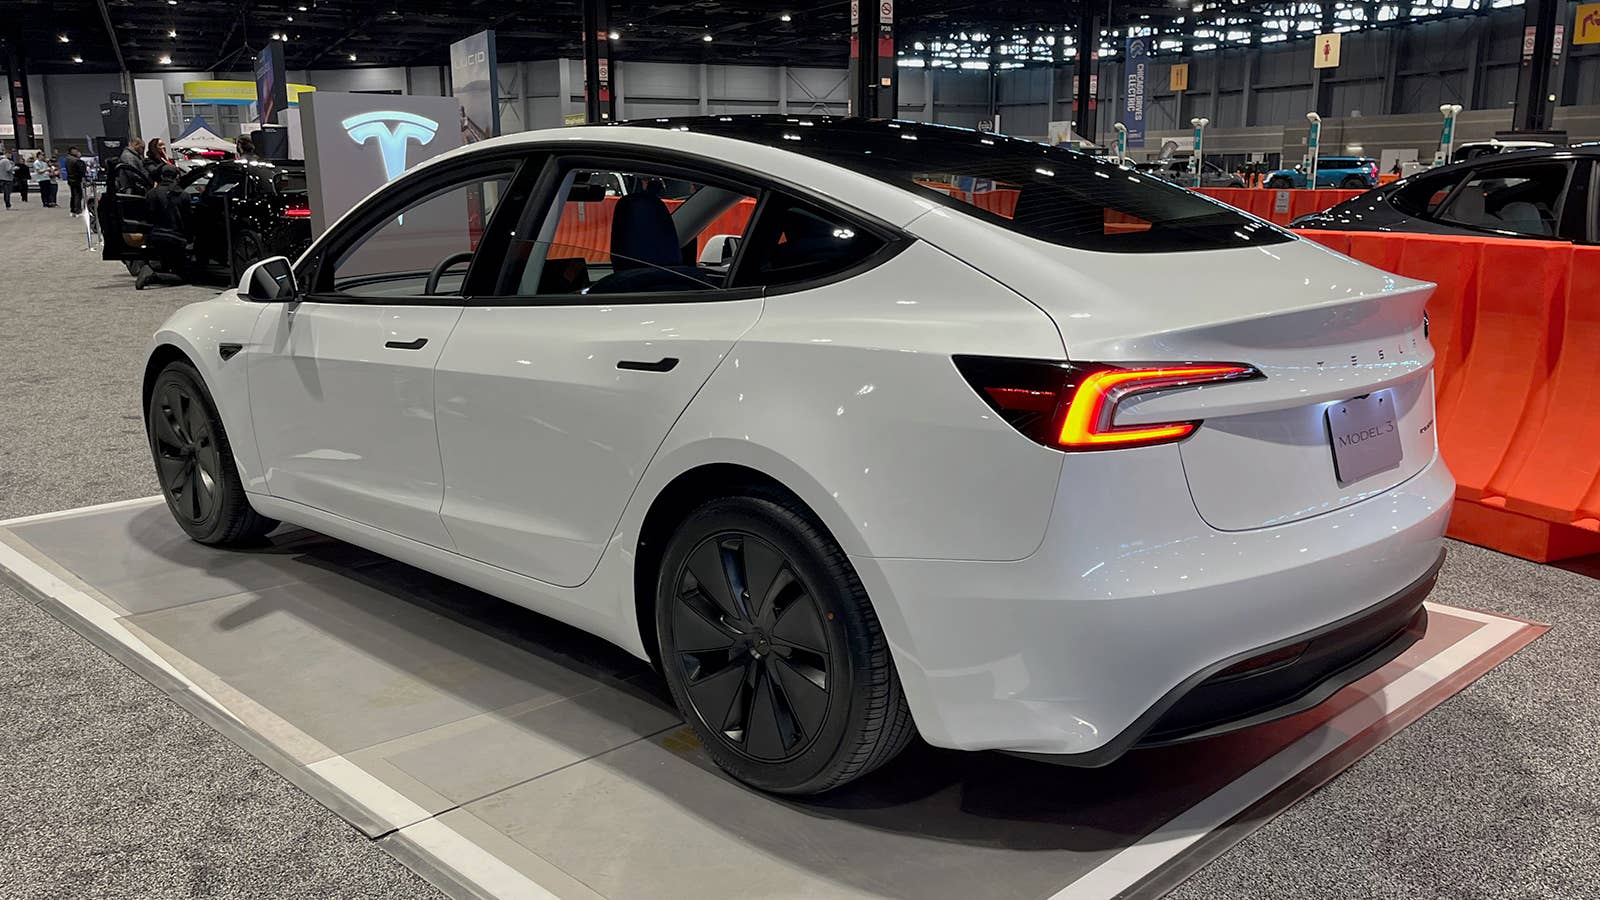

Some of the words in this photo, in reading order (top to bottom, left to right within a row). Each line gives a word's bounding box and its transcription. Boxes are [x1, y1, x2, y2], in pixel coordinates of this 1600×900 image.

[454, 51, 485, 69] LUCID
[1136, 63, 1144, 95] CHICAGO
[1127, 74, 1136, 112] ELECTRIC
[1135, 96, 1143, 121] DRIVES
[1338, 427, 1384, 447] MODEL
[1385, 420, 1394, 433] 3
